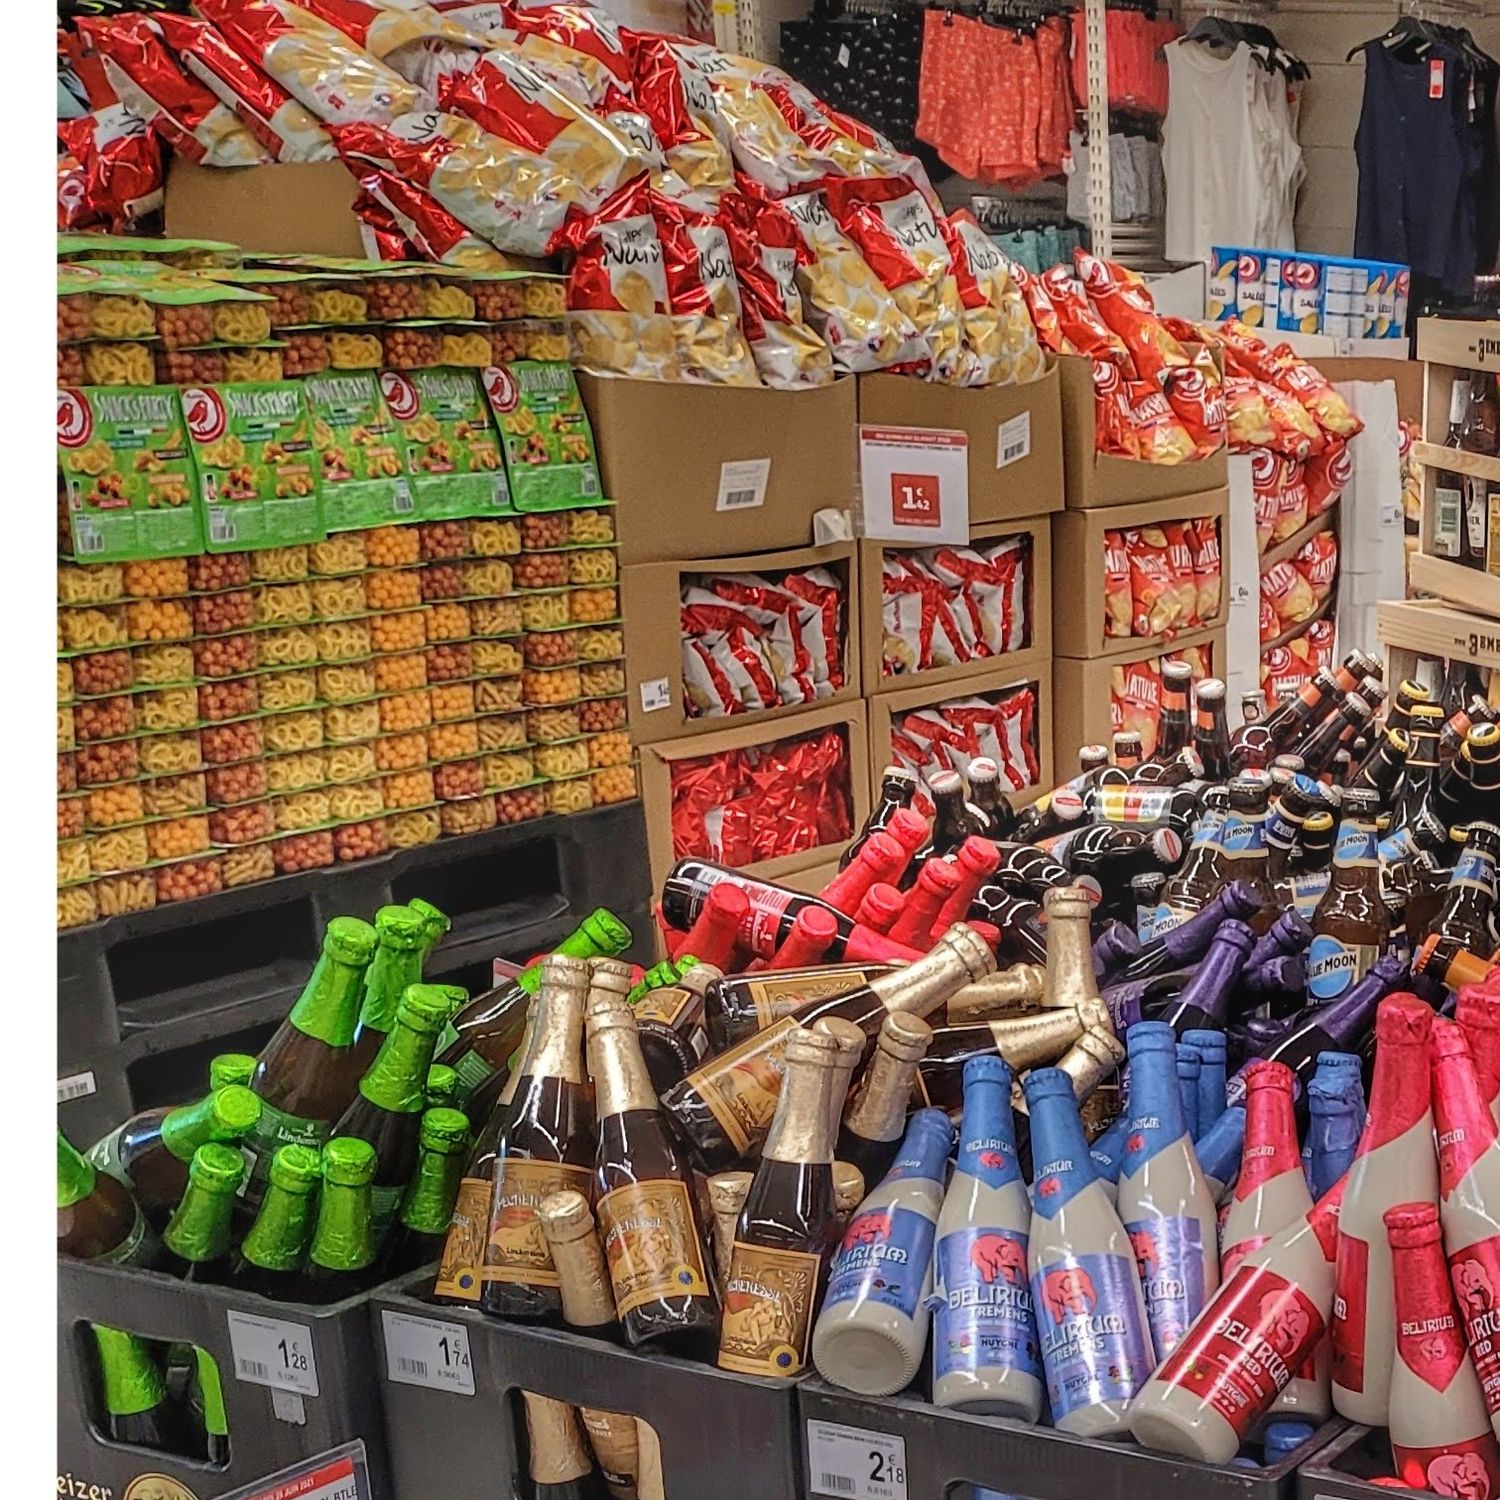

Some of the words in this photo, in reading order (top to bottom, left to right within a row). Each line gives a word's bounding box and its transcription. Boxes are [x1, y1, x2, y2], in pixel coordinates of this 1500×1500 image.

[1345, 833, 1368, 845] MOON
[1324, 953, 1357, 974] MOON
[949, 1283, 1032, 1311] DELIRIU
[969, 1305, 1029, 1323] TREMENS
[1400, 1314, 1454, 1337] DELIRIUM
[980, 1335, 1020, 1351] HUYGHE
[1052, 1336, 1105, 1363] TREMENS
[1215, 1315, 1290, 1391] DELIRIUM
[1474, 1339, 1492, 1360] RED
[1241, 1358, 1263, 1377] RED
[868, 1450, 905, 1484] 2€18
